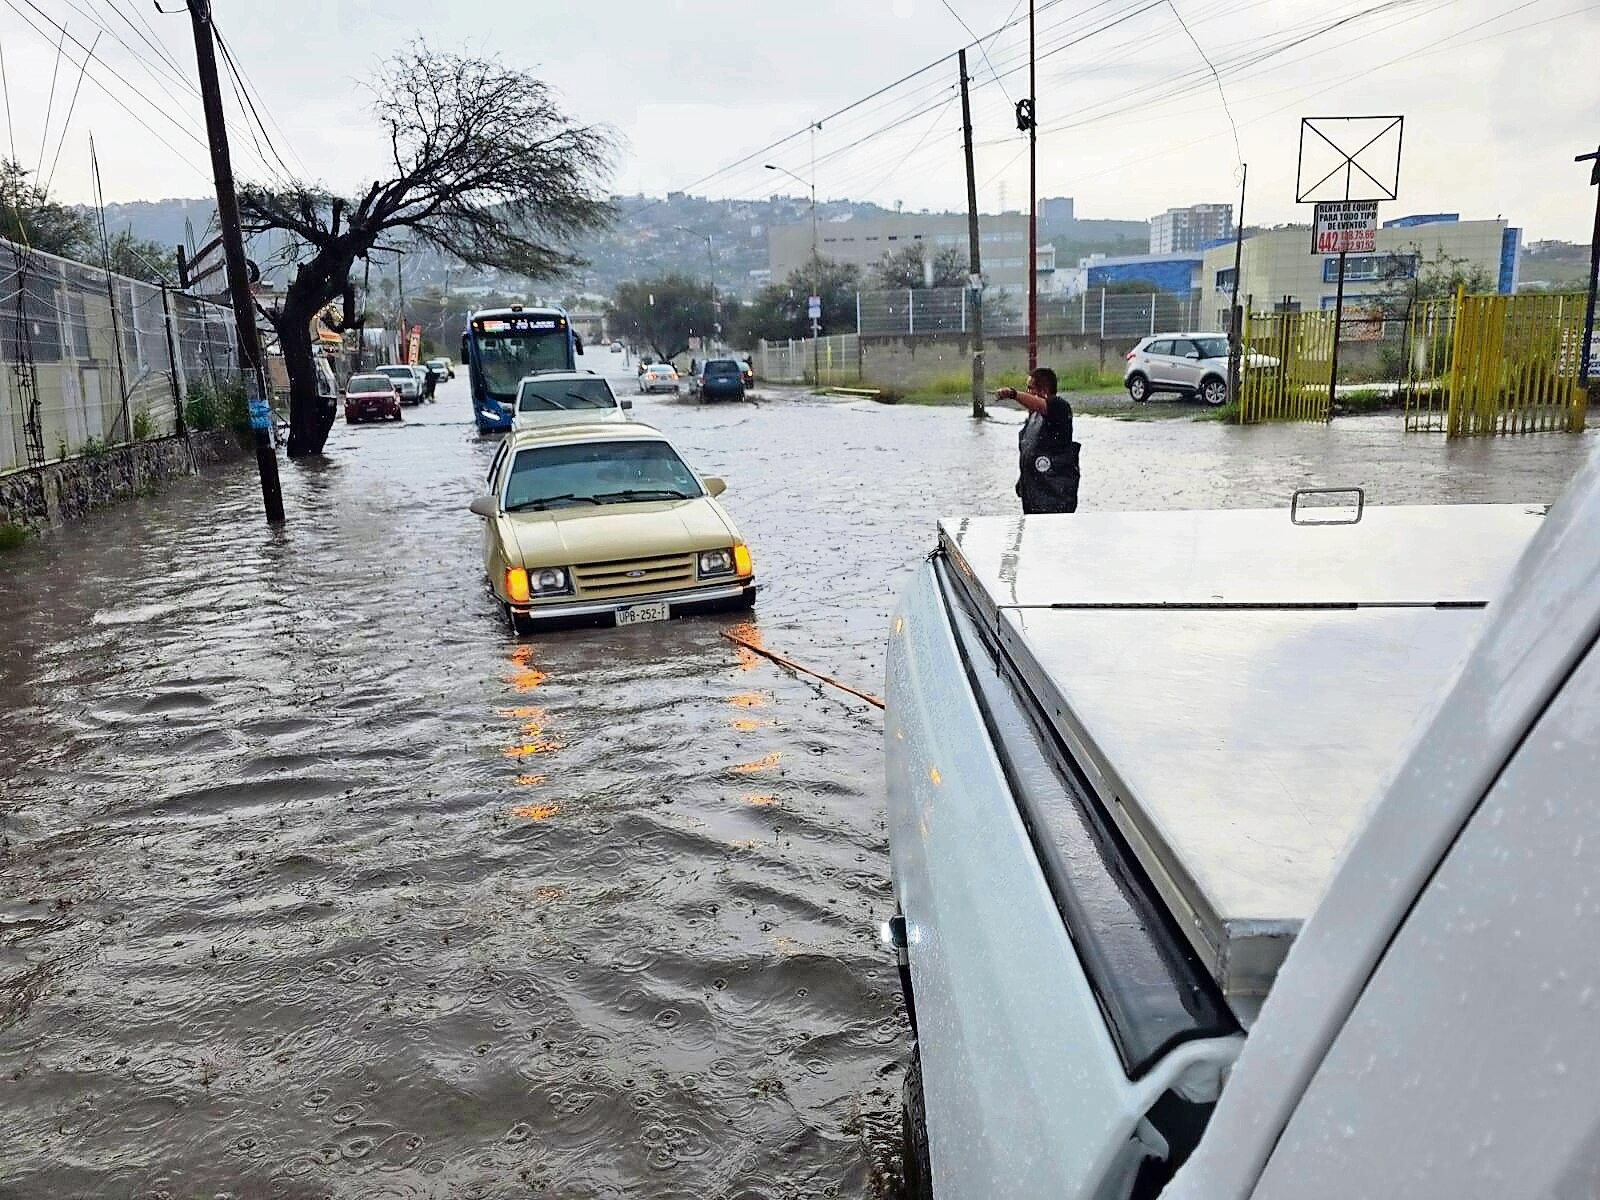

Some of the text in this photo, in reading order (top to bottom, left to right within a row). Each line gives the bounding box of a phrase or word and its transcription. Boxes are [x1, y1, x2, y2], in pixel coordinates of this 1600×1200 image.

[1319, 202, 1377, 213] RENTA DE EQUIPO
[1319, 211, 1377, 222] PARA TODO TIPO
[1327, 220, 1368, 231] DE EVENTOS
